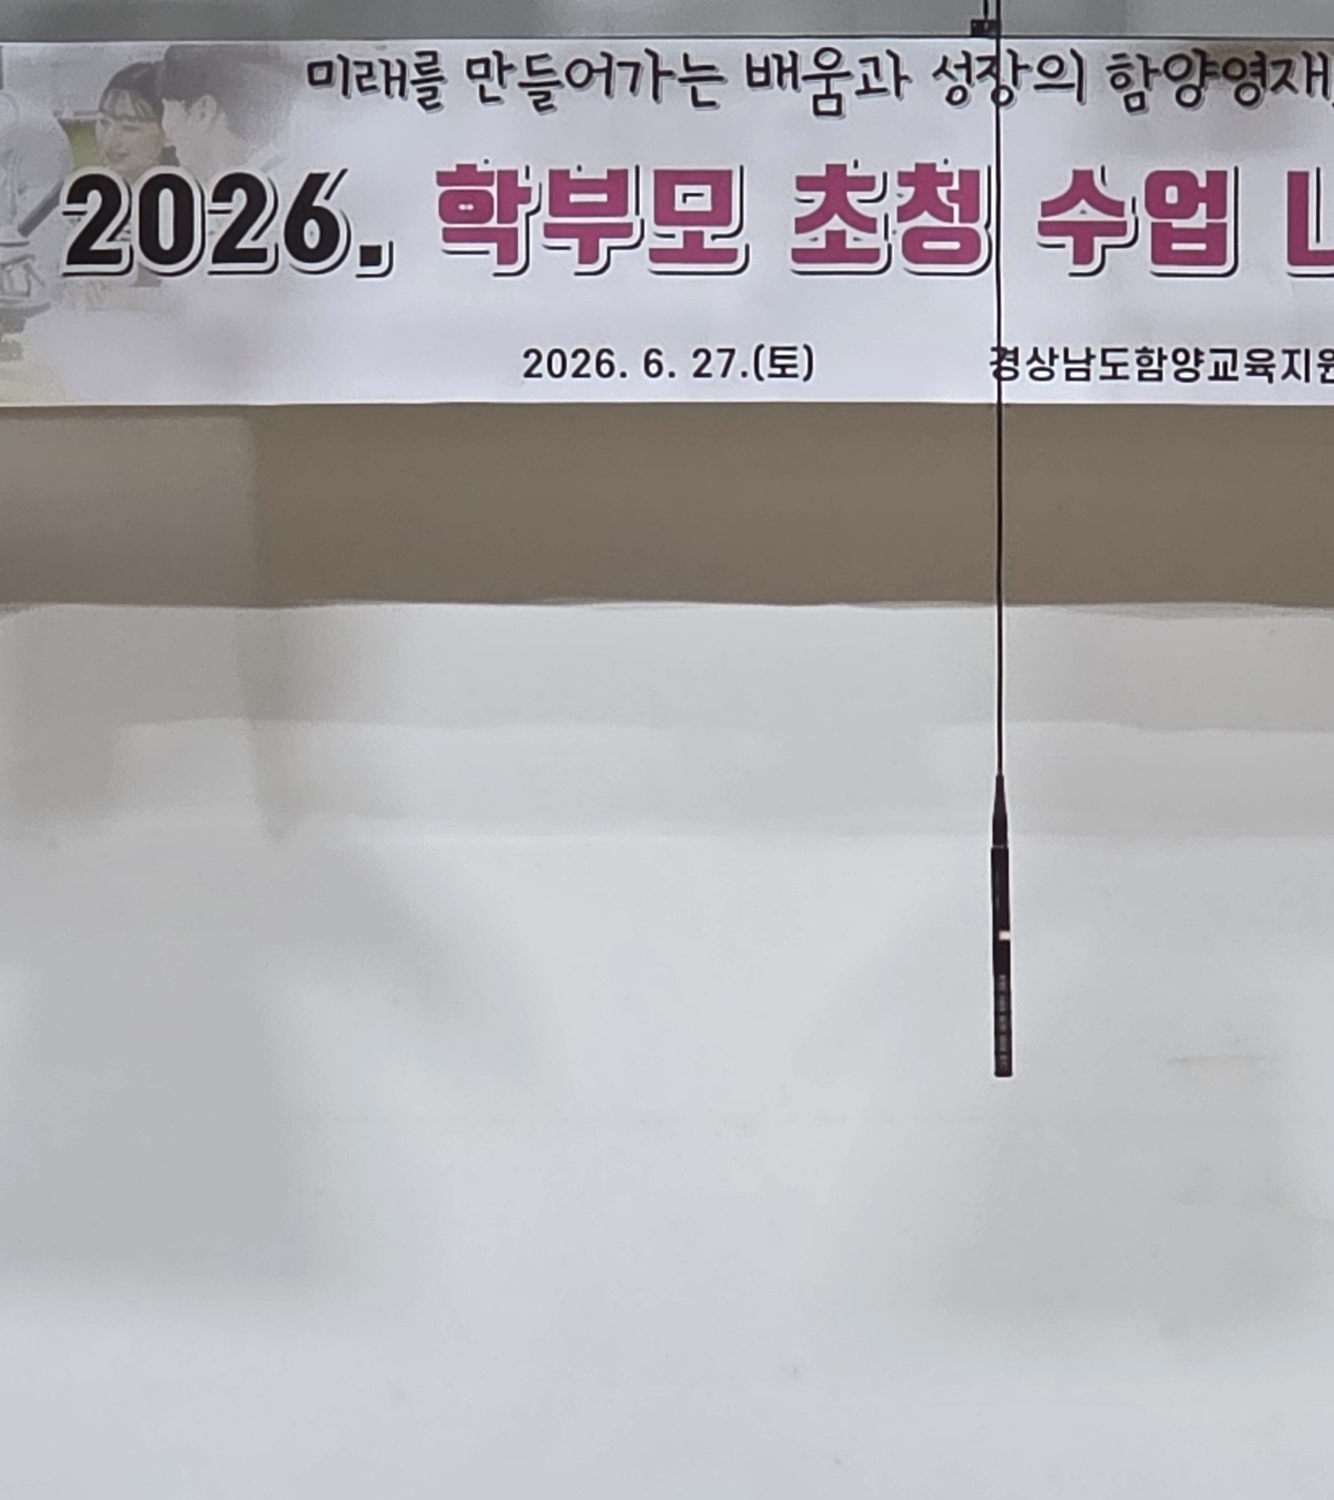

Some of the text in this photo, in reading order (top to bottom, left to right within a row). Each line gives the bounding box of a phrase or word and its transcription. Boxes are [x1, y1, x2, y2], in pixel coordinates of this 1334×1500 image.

[306, 49, 447, 112] 미래를
[465, 47, 727, 114] 만들어가는
[744, 45, 912, 118] 배움과
[931, 49, 1085, 110] 성장의
[64, 168, 391, 275] 2026.
[436, 164, 747, 274] 학부모
[790, 164, 991, 275] 초청
[1038, 166, 1237, 276] 수업
[522, 343, 814, 382] 2026. 6. 27.(토)
